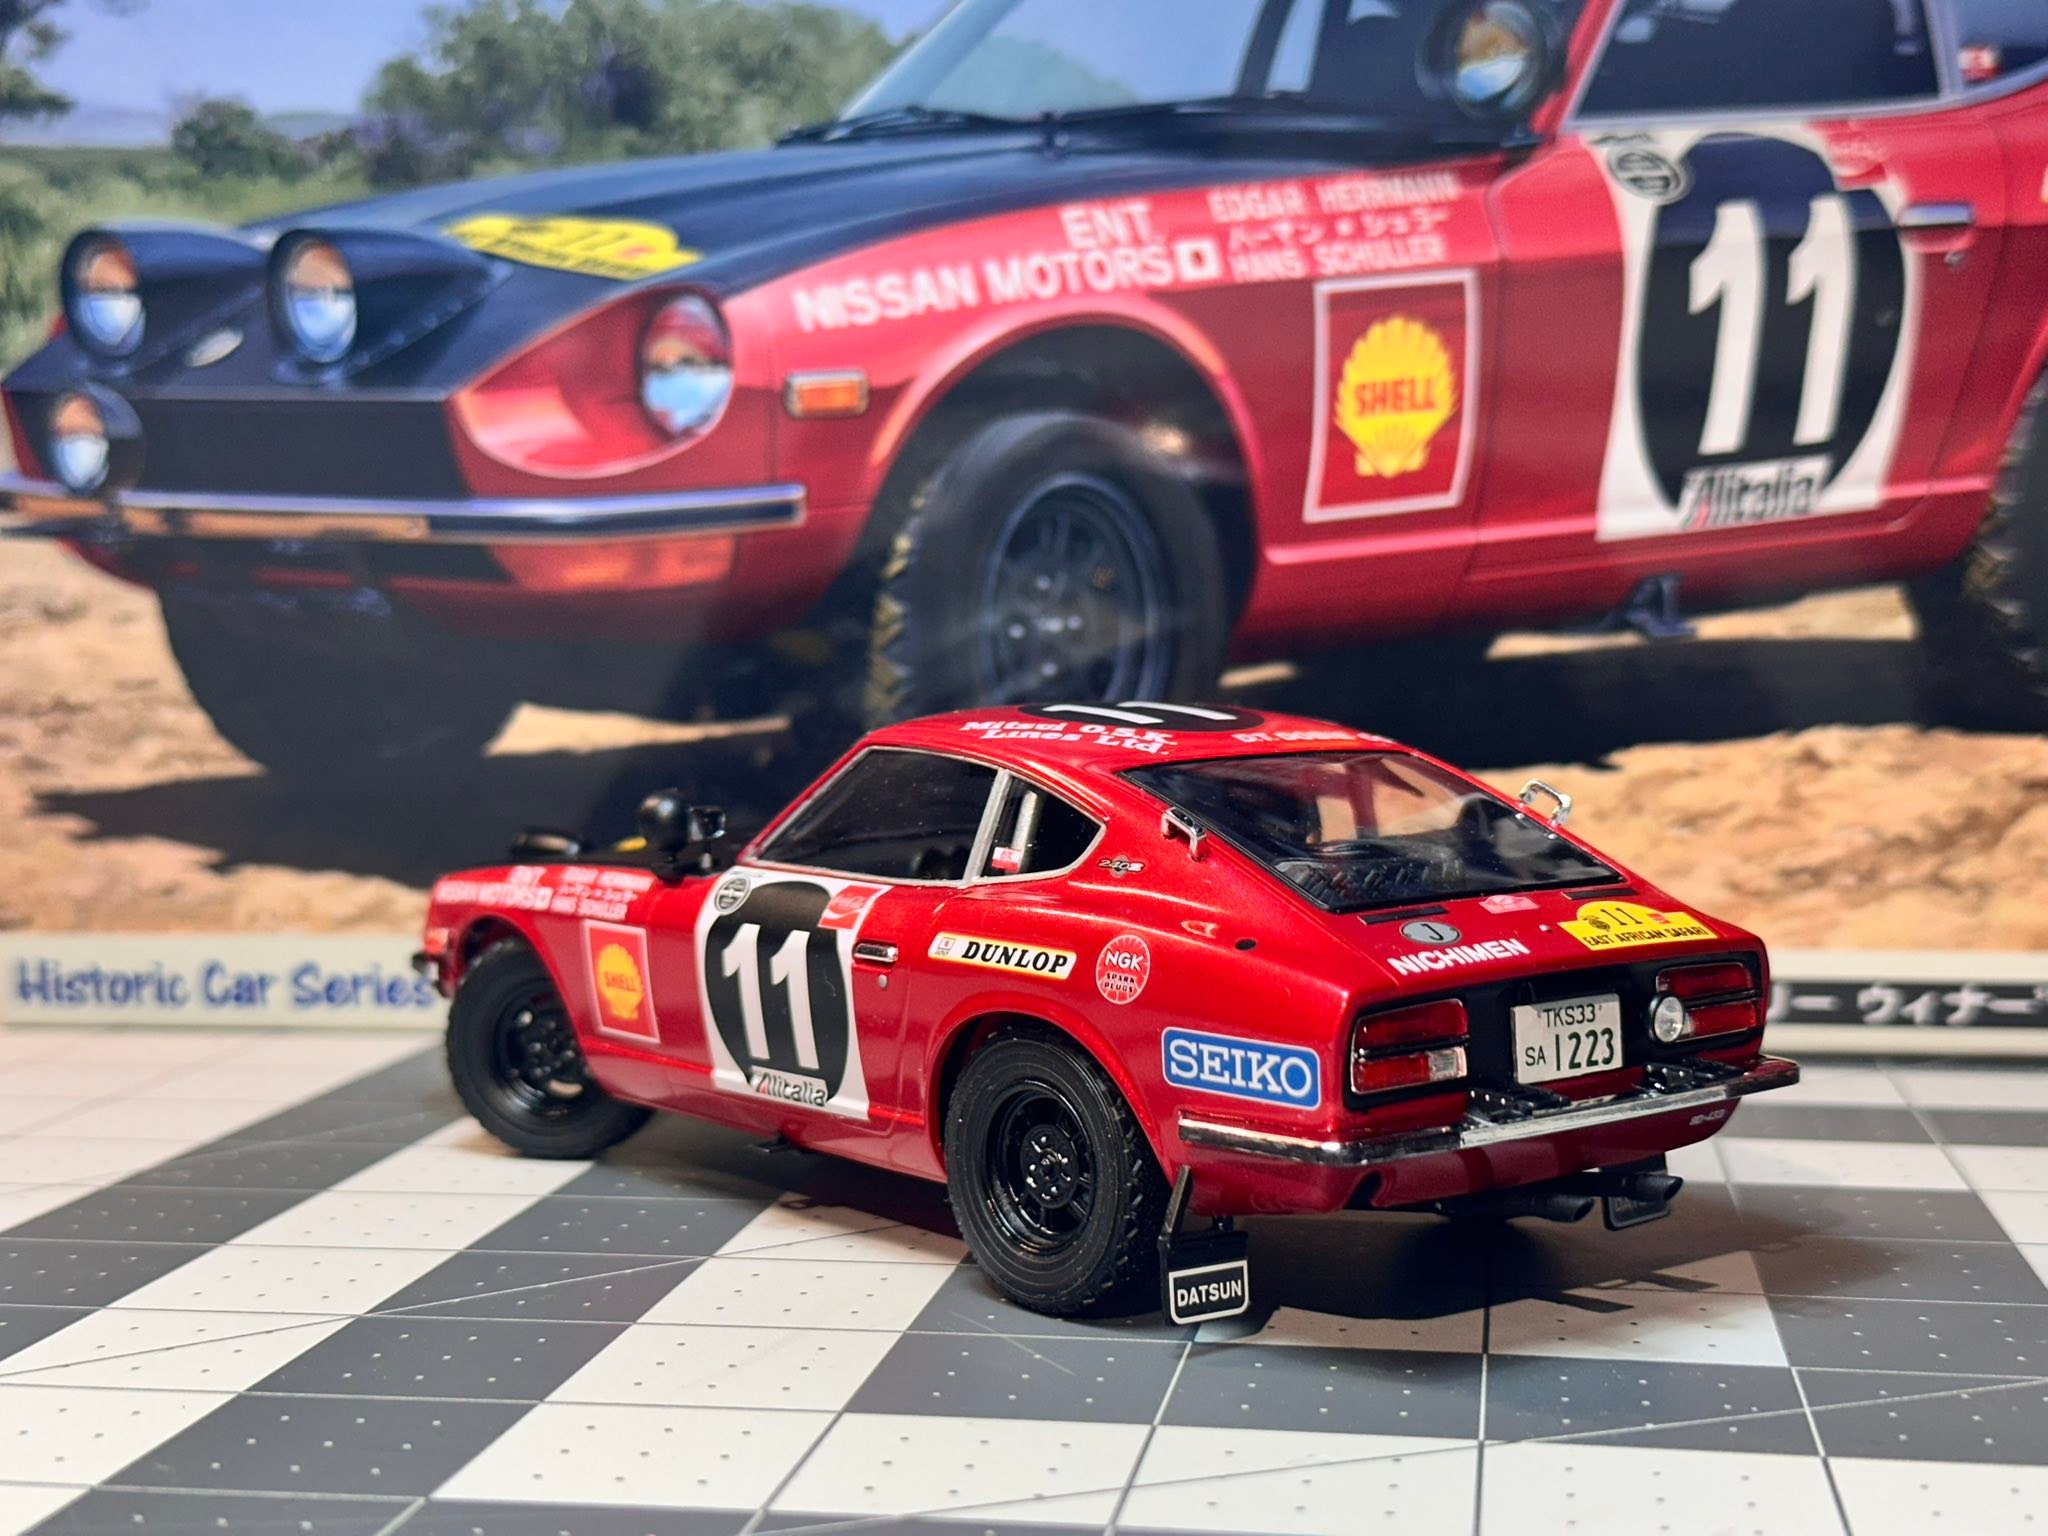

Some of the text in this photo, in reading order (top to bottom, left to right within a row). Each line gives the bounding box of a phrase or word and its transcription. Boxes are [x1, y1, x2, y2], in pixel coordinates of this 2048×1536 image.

[1208, 184, 1304, 223] EDGAR
[1060, 202, 1151, 250] ENT
[1228, 248, 1307, 282] HANS
[793, 245, 1173, 331] NISSAN MOTORS
[1690, 193, 1853, 455] 11
[1354, 377, 1436, 417] SHELL
[1684, 463, 1815, 528] Alitalia
[959, 721, 1067, 731] Mitsui
[1041, 701, 1237, 724] 11
[980, 729, 1169, 755] Lines Ltd.
[1421, 923, 1444, 941] J
[1600, 907, 1643, 925] 11
[1582, 925, 1710, 946] EAST AFRICAN SAFARI
[962, 940, 1068, 973] DUNLOP
[1105, 949, 1144, 972] NGK
[1387, 938, 1531, 975] NICHIMEN
[17, 959, 437, 1009] Historic Car Series
[604, 972, 637, 992] SHELL
[1106, 973, 1135, 984] SPARK
[722, 923, 820, 1070] 11
[1543, 1003, 1596, 1028] TKS33
[1525, 1027, 1614, 1071] SA 1223
[1168, 1038, 1313, 1097] SEIKO
[755, 1071, 828, 1107] Alitalia
[1177, 1279, 1242, 1307] DATSUN
